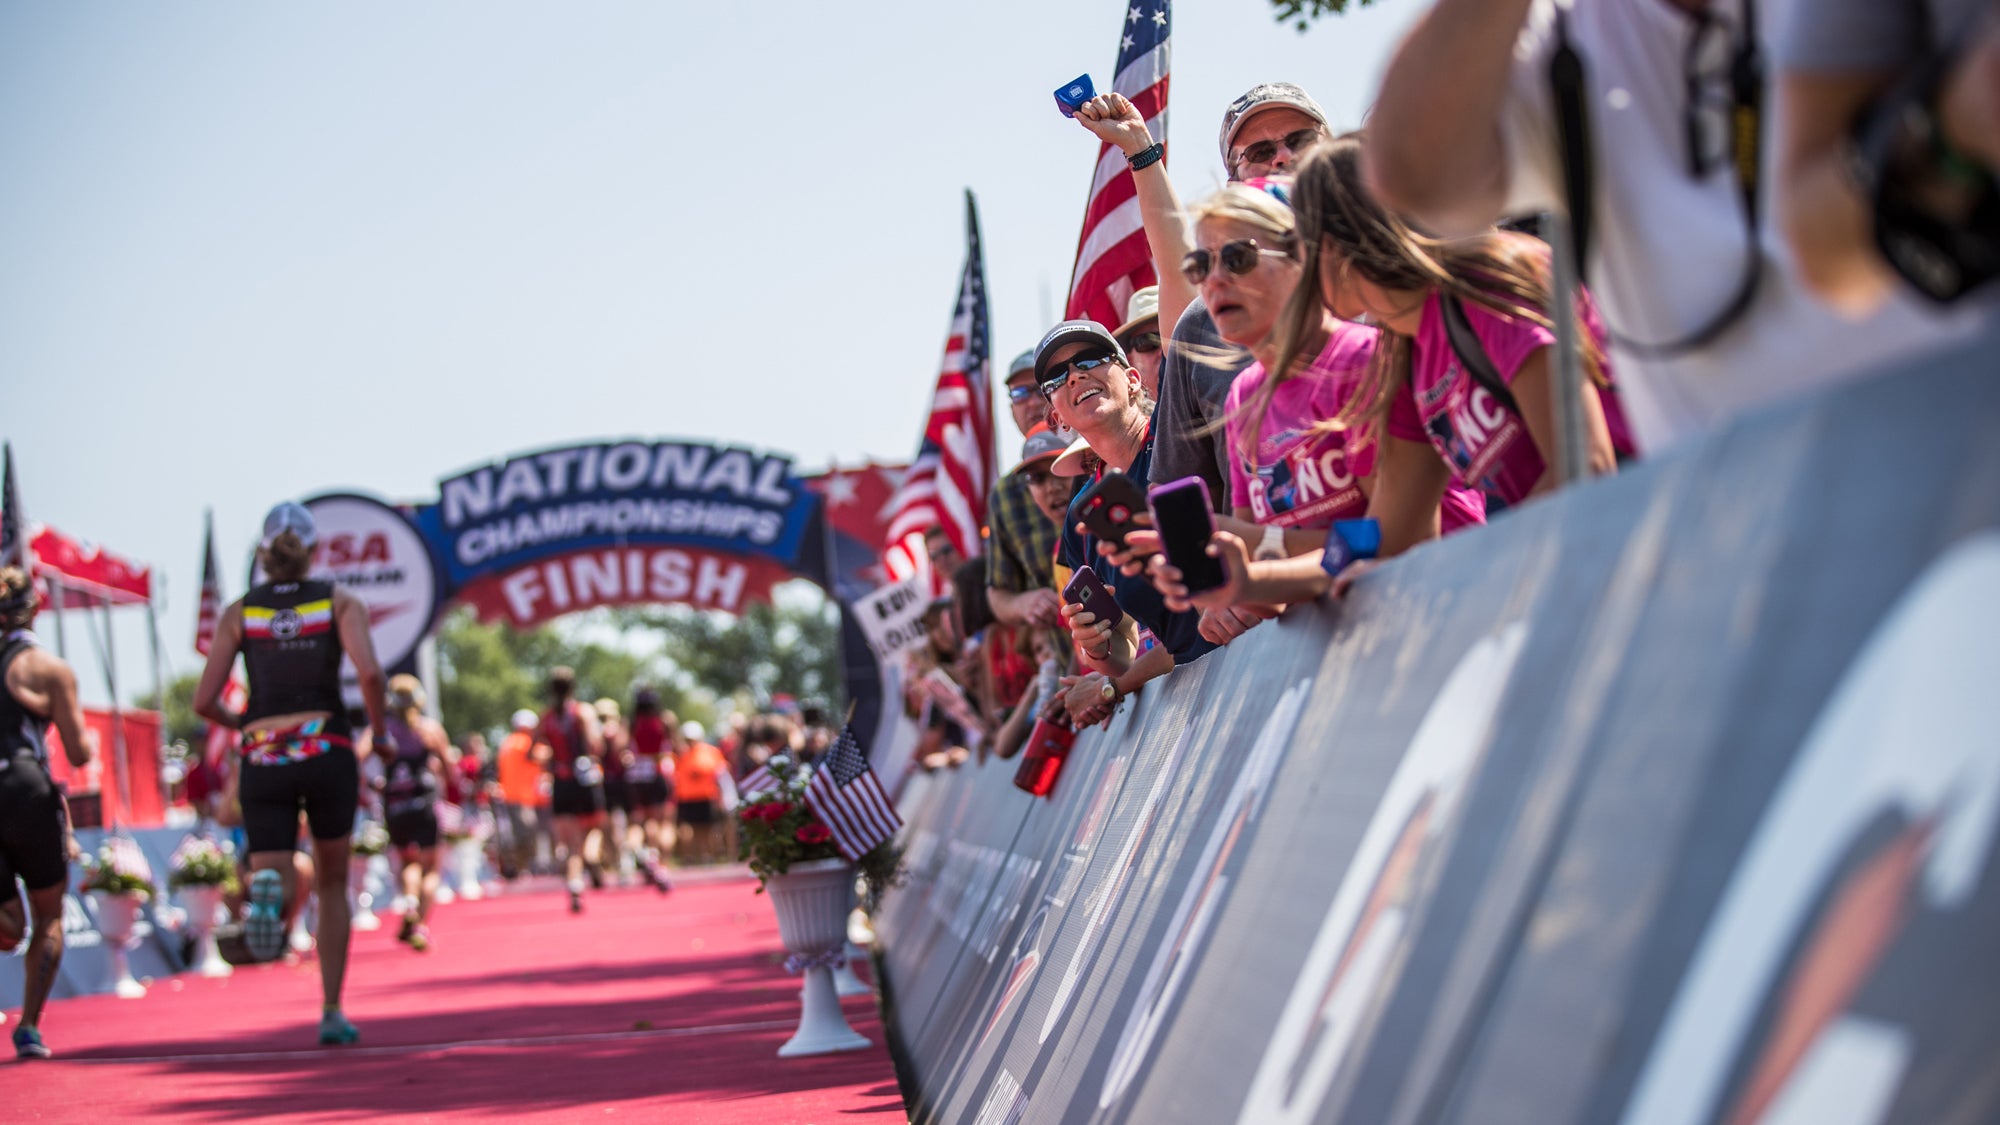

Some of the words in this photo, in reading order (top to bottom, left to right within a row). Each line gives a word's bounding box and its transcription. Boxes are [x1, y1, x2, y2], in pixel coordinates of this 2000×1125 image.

[443, 442, 793, 527] NATIONAL
[456, 500, 780, 565] CHAMPIONSHIPS
[505, 550, 749, 625] FINISH
